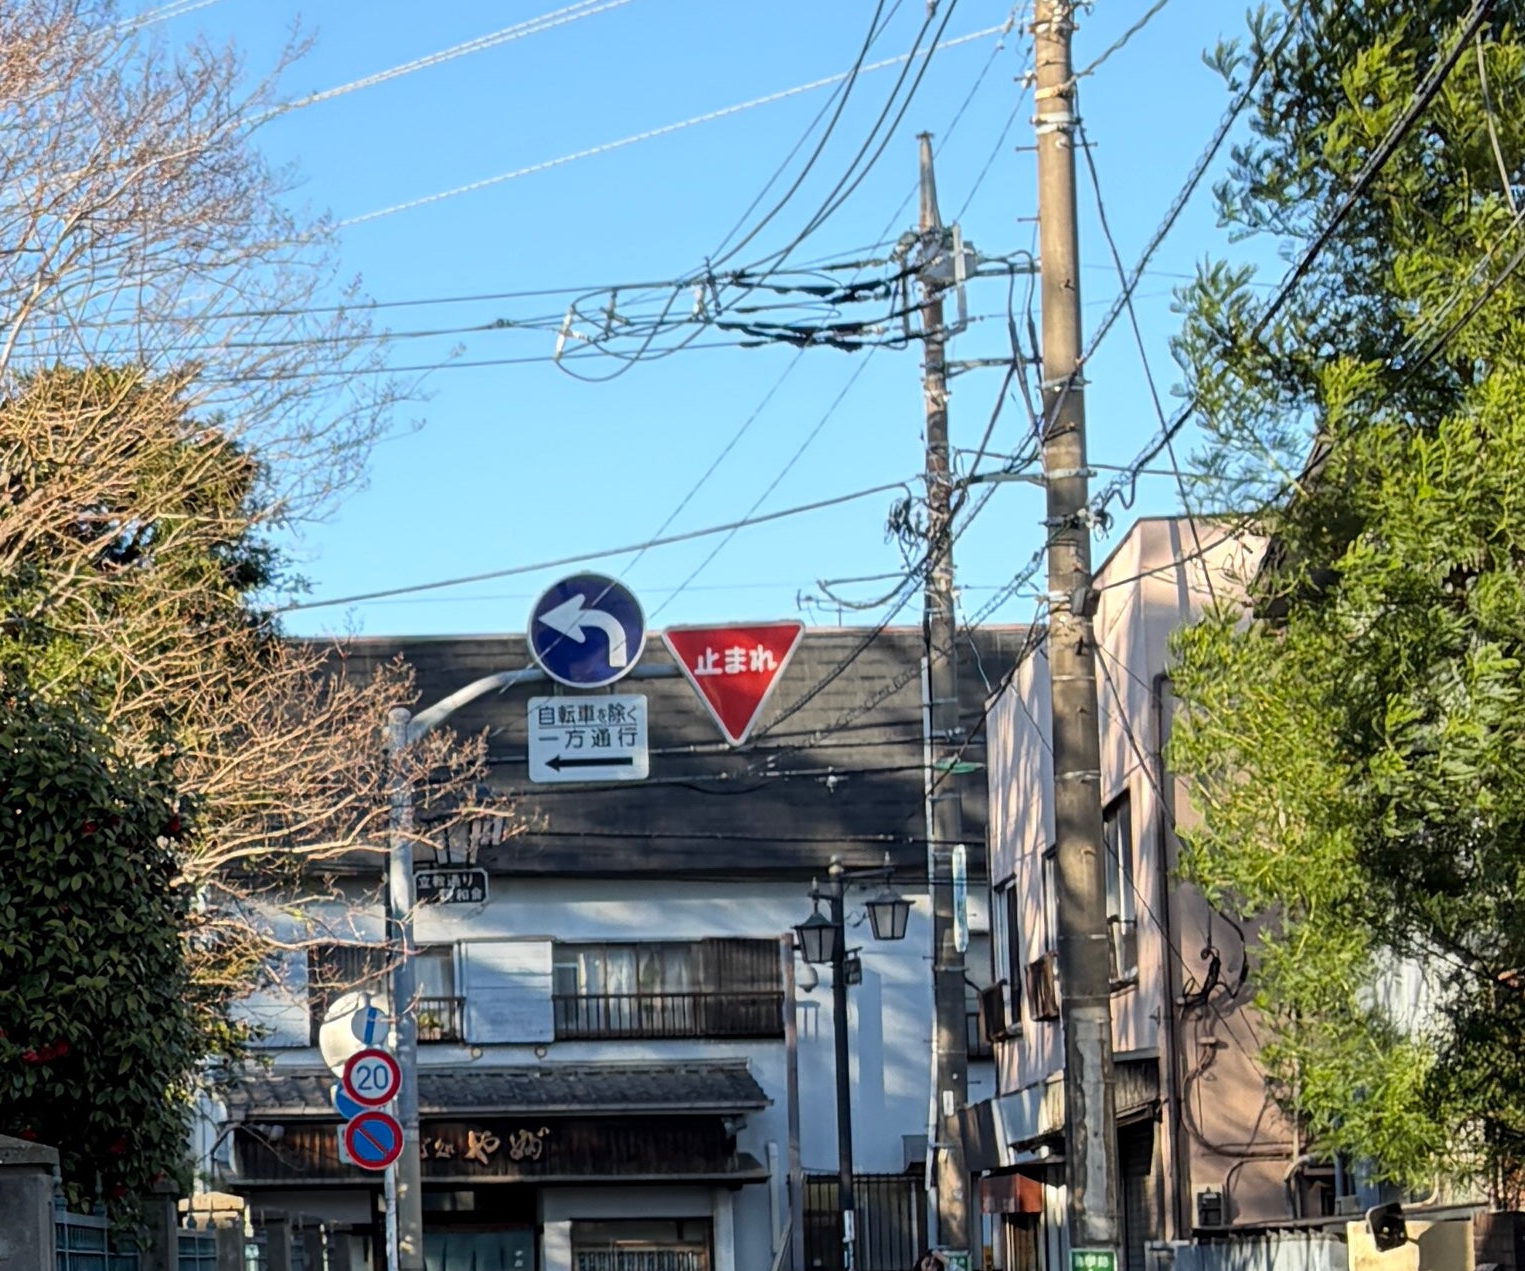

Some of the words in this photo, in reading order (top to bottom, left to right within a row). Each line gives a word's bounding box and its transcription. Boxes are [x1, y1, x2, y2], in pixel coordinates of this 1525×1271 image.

[693, 644, 778, 676] 止まれ
[538, 704, 638, 726] 自転車を除く
[537, 728, 639, 750] 一方通行
[356, 1064, 389, 1091] 20
